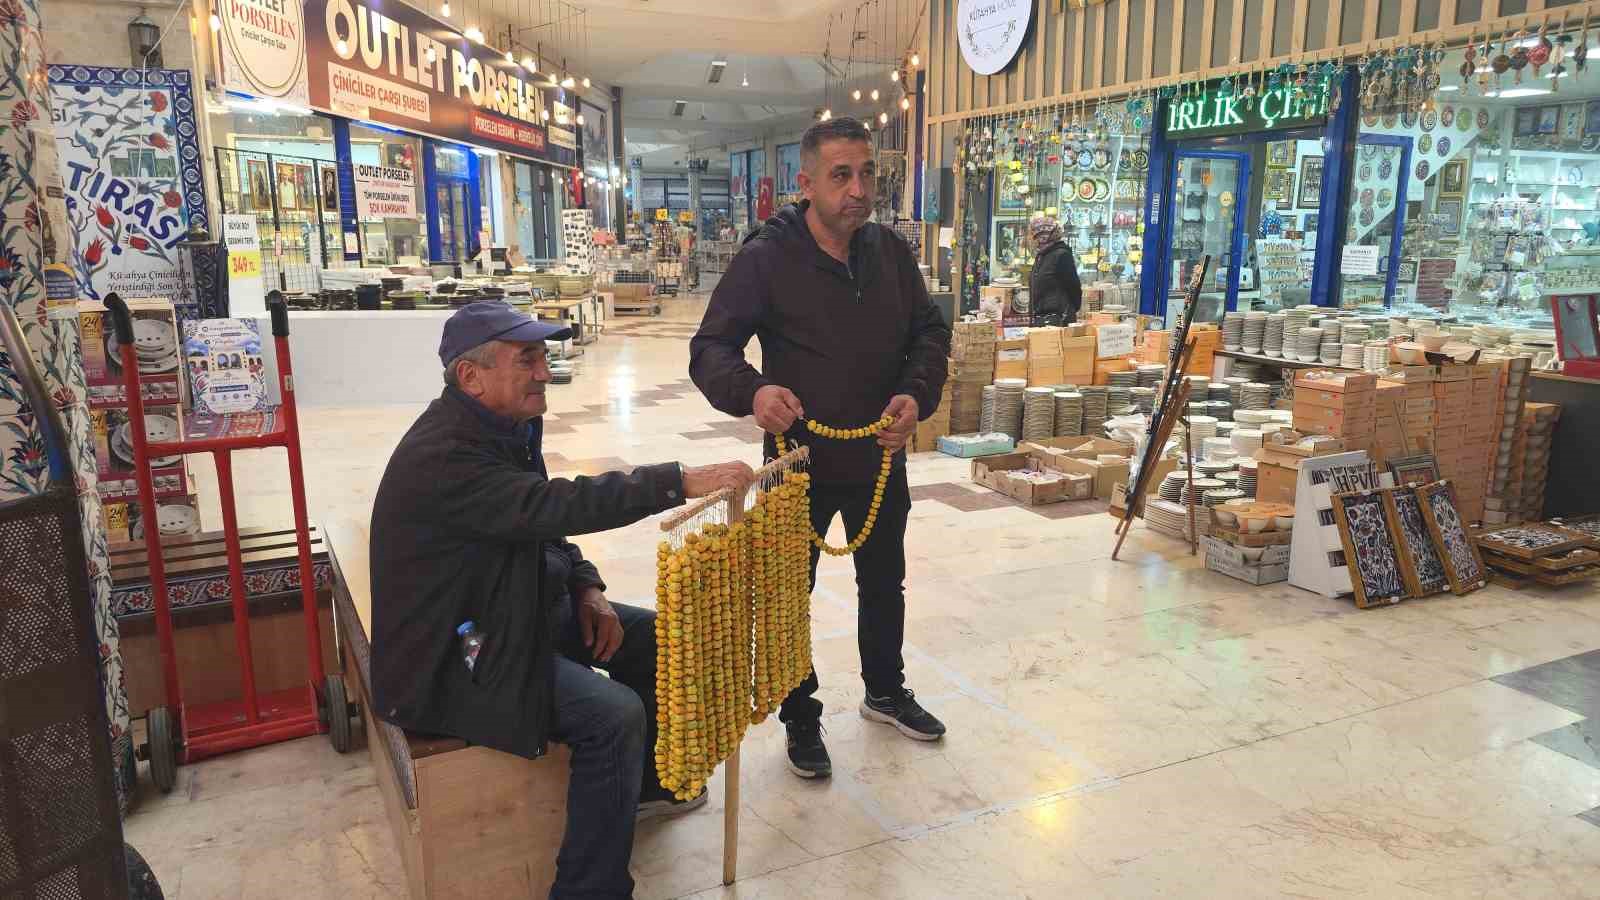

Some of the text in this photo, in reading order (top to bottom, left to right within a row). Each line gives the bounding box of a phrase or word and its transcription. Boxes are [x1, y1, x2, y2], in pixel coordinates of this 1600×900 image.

[231, 0, 296, 40] PORSELEN
[326, 0, 545, 127] OUTLET PORSELEN
[358, 164, 411, 182] OUTLET PORSELEN
[232, 256, 248, 272] 349
[83, 316, 98, 328] 24
